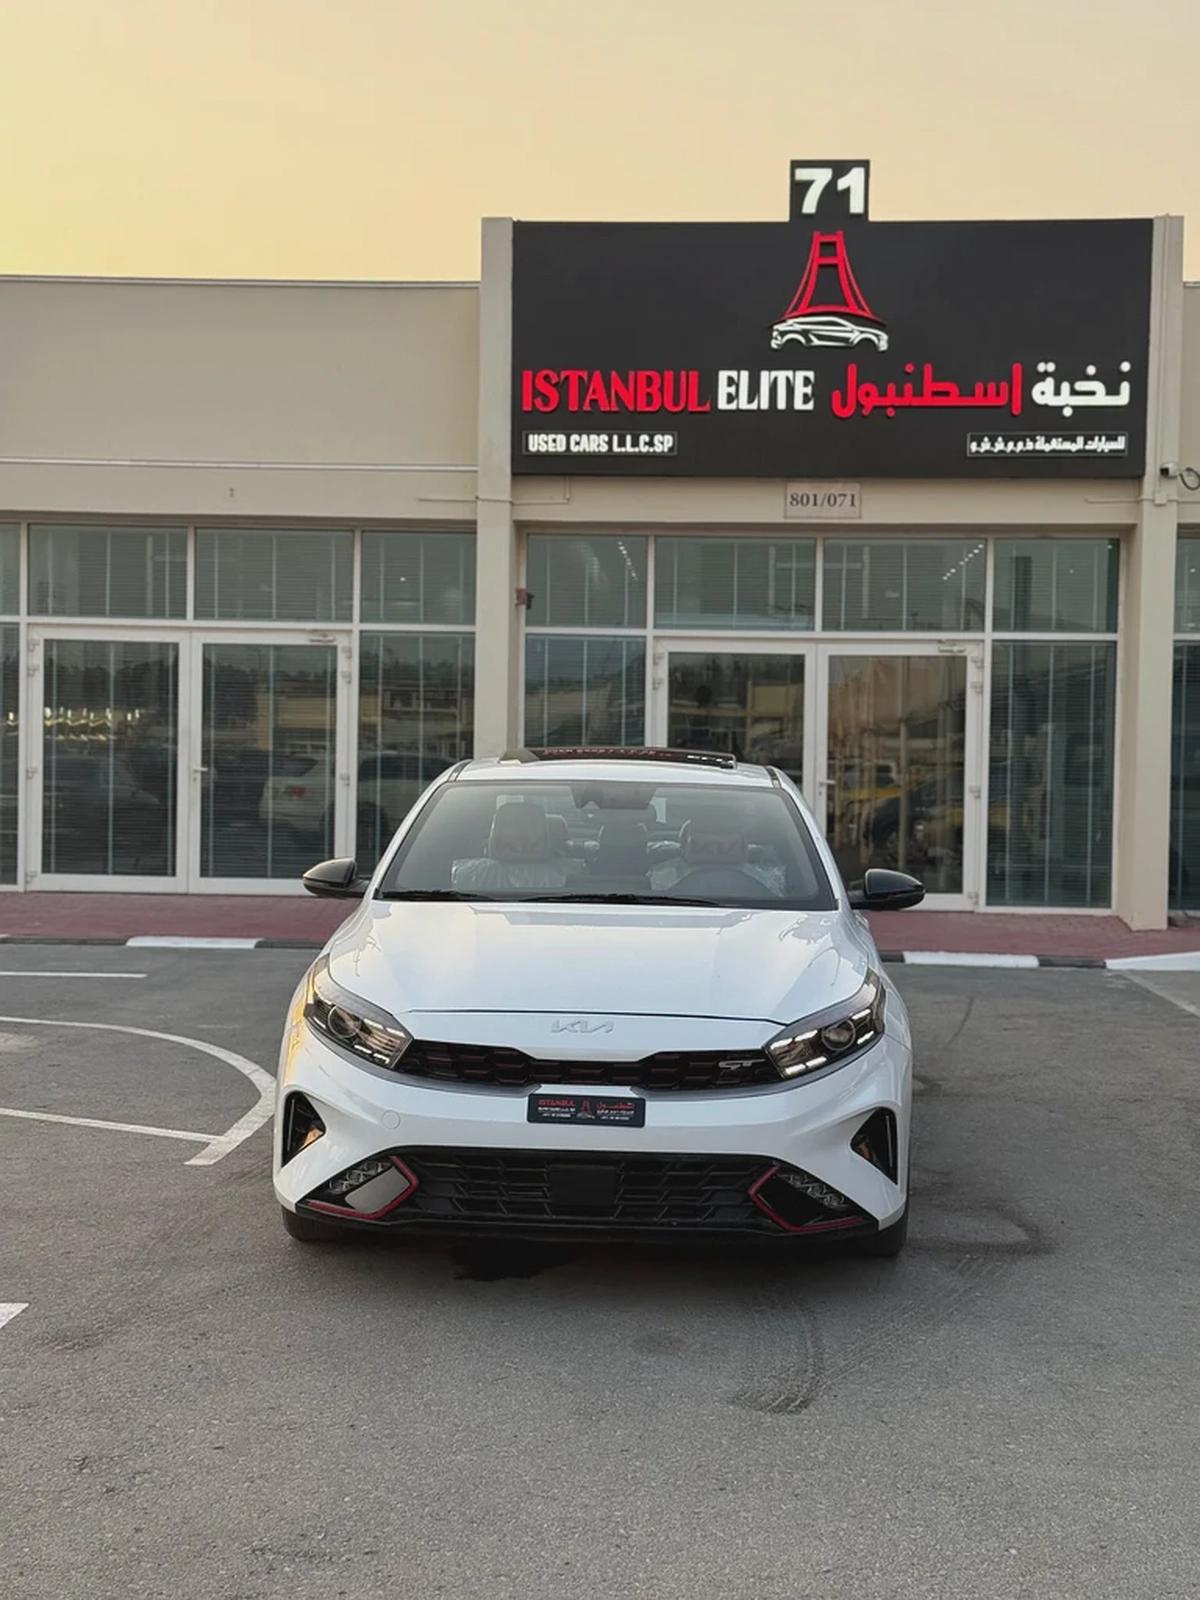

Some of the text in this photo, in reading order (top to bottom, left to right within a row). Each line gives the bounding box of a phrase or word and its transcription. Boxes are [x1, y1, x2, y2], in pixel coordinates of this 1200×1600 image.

[794, 167, 866, 214] 71
[521, 369, 816, 414] ISTANBUL ELITE
[831, 361, 1132, 419] نخبة اسطنبول
[527, 433, 674, 453] USED CARS L.L.C.SP
[789, 492, 857, 508] 801/071
